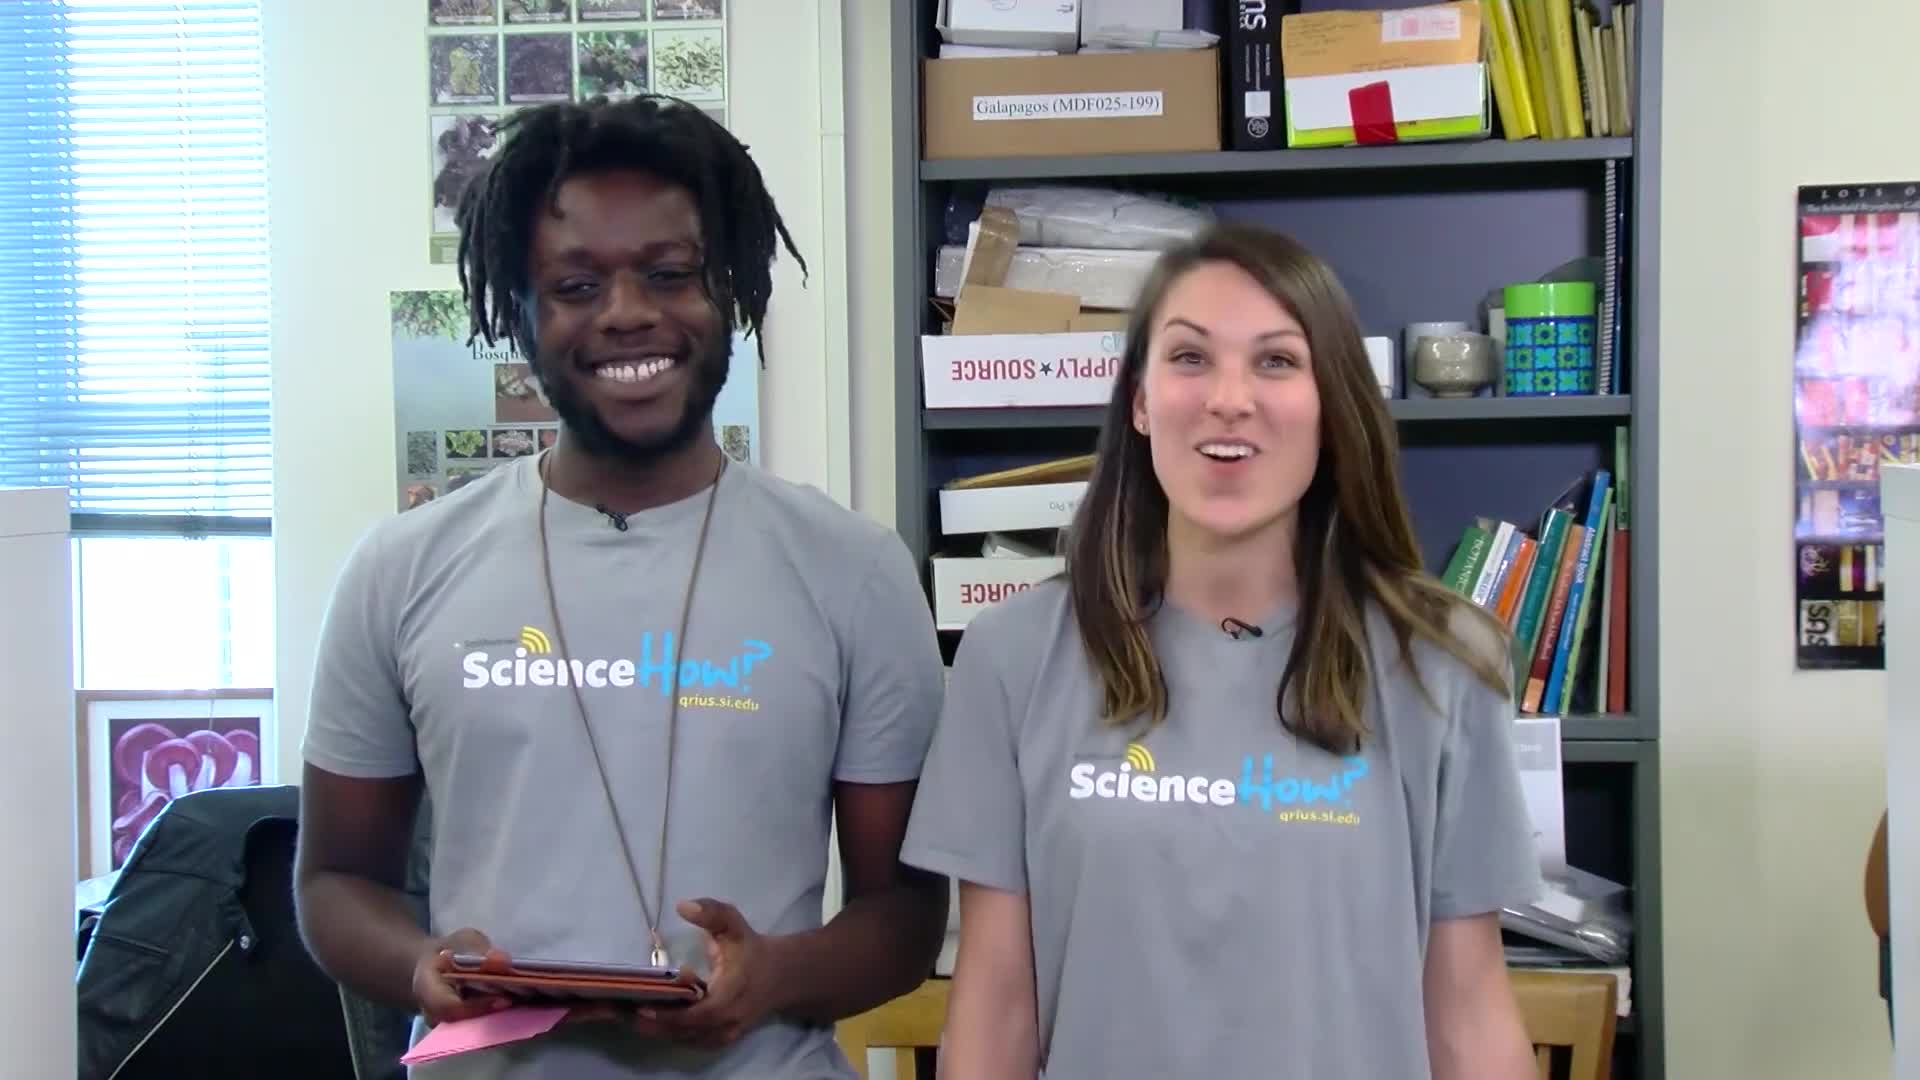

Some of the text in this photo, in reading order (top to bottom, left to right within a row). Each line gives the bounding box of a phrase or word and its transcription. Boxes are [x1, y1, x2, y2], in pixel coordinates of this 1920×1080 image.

[976, 93, 1160, 119] Galapagos (MDF025-199)
[1821, 187, 1883, 200] LOTS
[472, 336, 526, 362] Bosqu
[951, 359, 1036, 381] SOURCE
[463, 630, 774, 697] Science How?
[1070, 752, 1371, 811] Science How?
